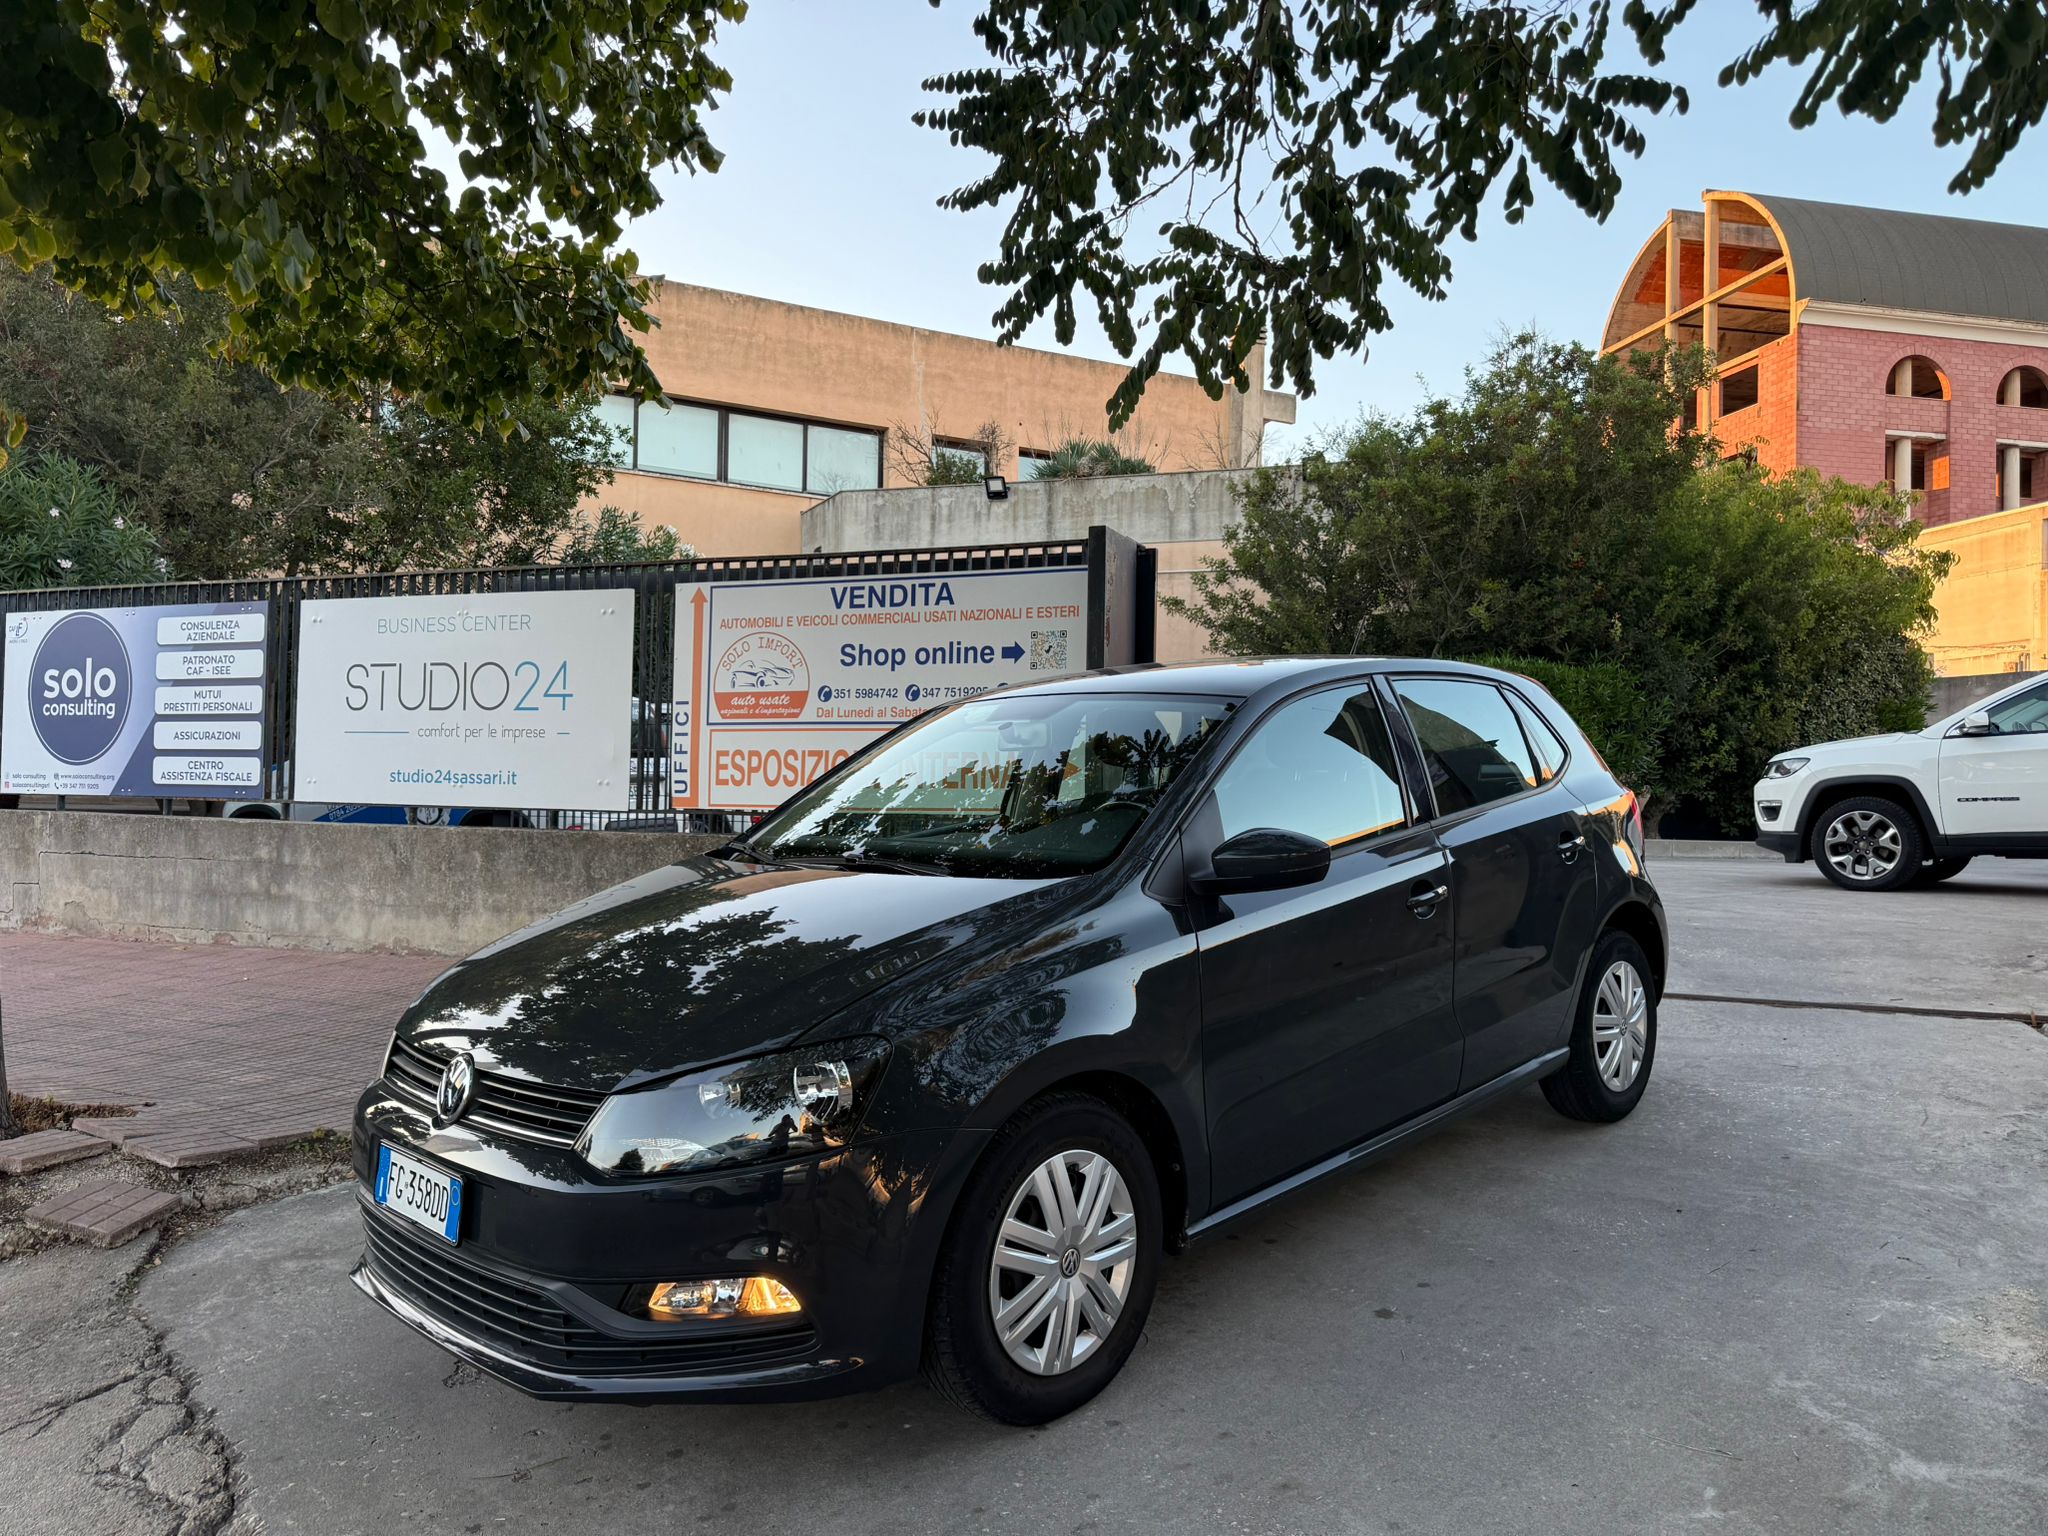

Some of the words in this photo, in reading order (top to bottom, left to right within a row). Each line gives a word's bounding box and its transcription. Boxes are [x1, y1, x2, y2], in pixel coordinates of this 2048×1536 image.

[830, 582, 955, 609] VENDITA
[720, 616, 783, 630] AUTOMOBILI
[786, 616, 793, 627] E
[796, 614, 838, 627] VEICOLI
[841, 611, 920, 626] COMMERCIALI
[924, 610, 957, 623] USATI
[960, 608, 1022, 621] NAZIONALI
[1026, 607, 1033, 619] E
[1036, 605, 1080, 618] ESTERI
[180, 621, 240, 632] CONSULENZA
[377, 616, 456, 634] BUSINESS
[462, 614, 532, 632] CENTER
[186, 631, 235, 641] AZIENDALE
[722, 640, 751, 671] SOLO
[757, 636, 805, 669] IMPORT
[840, 643, 906, 672] Shop
[915, 641, 995, 665] online
[182, 655, 235, 666] PATRONATO
[186, 666, 204, 676] CAF
[212, 665, 231, 675] ISEE
[43, 657, 117, 698] solo
[345, 660, 574, 711] STUDIO24
[194, 690, 222, 700] MUTUI
[834, 689, 851, 699] 351
[855, 688, 898, 699] 5984742
[922, 687, 941, 698] 347
[731, 694, 755, 705] auto
[759, 693, 791, 705] usate
[42, 699, 116, 719] consulting
[163, 702, 201, 712] PRESTITI
[202, 701, 253, 711] PERSONALI
[816, 707, 834, 718] Dal
[877, 707, 887, 718] al
[173, 730, 241, 741] ASSICURAZIONI
[417, 722, 461, 738] comfort
[464, 727, 484, 743] per
[488, 723, 498, 738] le
[502, 725, 546, 743] imprese
[674, 701, 689, 794] UFFICI
[188, 761, 224, 771] CENTRO
[160, 772, 213, 781] ASSISTENZA
[215, 772, 252, 782] FISCALE
[389, 769, 517, 786] studio24sassari.it
[388, 1161, 405, 1199] FG
[407, 1170, 449, 1222] 358DD
